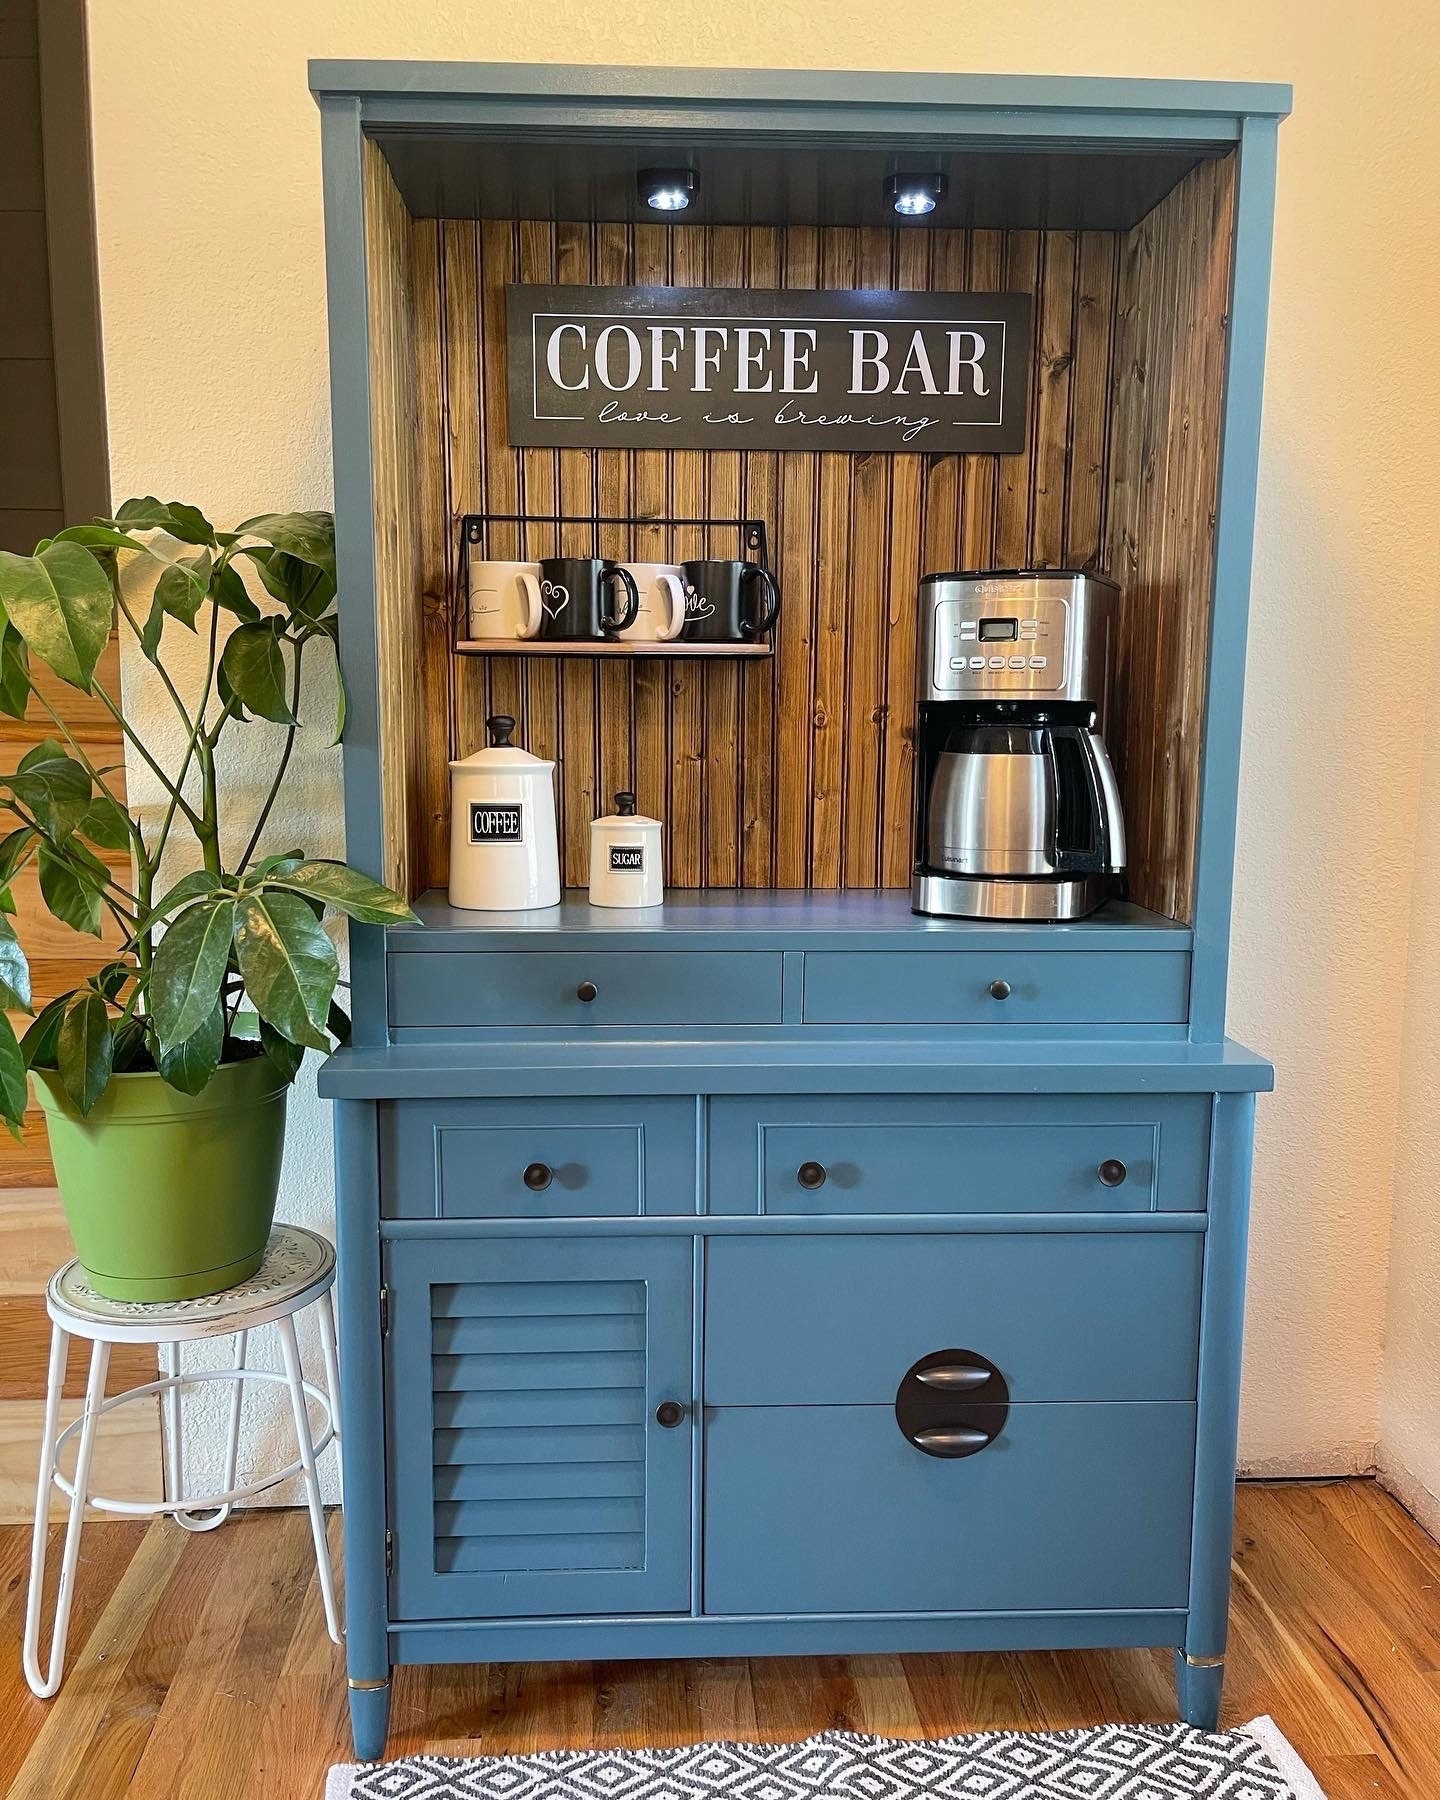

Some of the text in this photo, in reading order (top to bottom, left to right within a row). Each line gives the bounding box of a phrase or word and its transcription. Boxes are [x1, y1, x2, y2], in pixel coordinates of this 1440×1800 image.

[546, 324, 991, 397] COFFEE BAR
[598, 399, 940, 442] love is brewing
[474, 811, 519, 834] COFFEE
[612, 852, 641, 866] SUGAR
